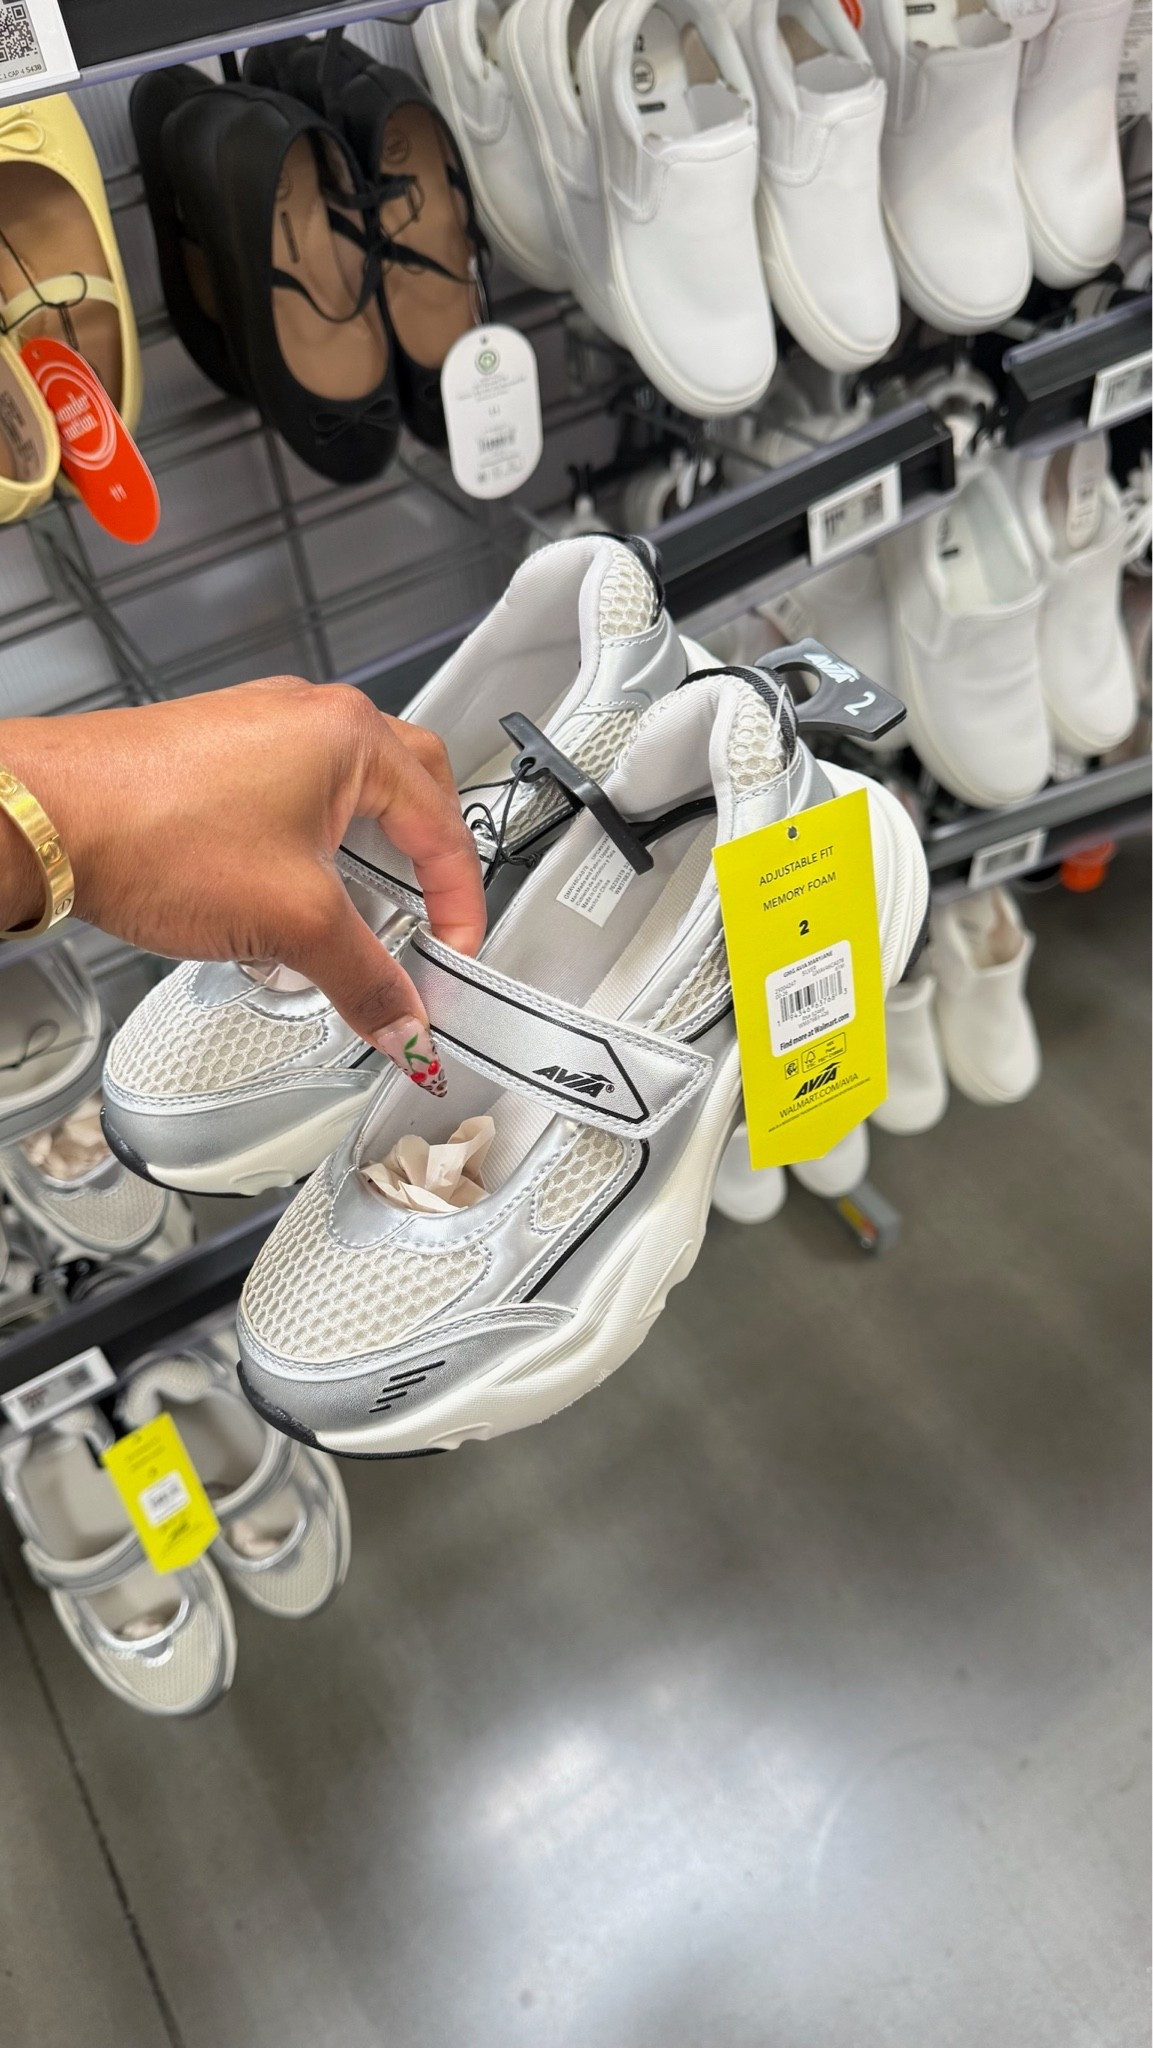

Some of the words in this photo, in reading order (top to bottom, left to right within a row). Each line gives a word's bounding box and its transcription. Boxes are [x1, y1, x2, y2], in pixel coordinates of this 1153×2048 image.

[843, 690, 877, 717] 2
[576, 880, 587, 893] Made
[599, 845, 611, 859] Upper
[759, 853, 817, 886] ADJUSTABLE
[820, 845, 834, 859] FIT
[580, 897, 590, 909] Made
[592, 879, 603, 892] China
[600, 879, 611, 893] China
[763, 885, 805, 911] MEMORY
[808, 872, 836, 892] FOAM
[798, 919, 810, 936] 2
[780, 1038, 792, 1050] Find
[793, 1033, 808, 1044] more
[814, 1012, 850, 1033] Walmart.com
[532, 1065, 614, 1098] AVIA
[779, 1073, 859, 1118] WALMART.COM/AVIA
[793, 1061, 842, 1101] AVIA
